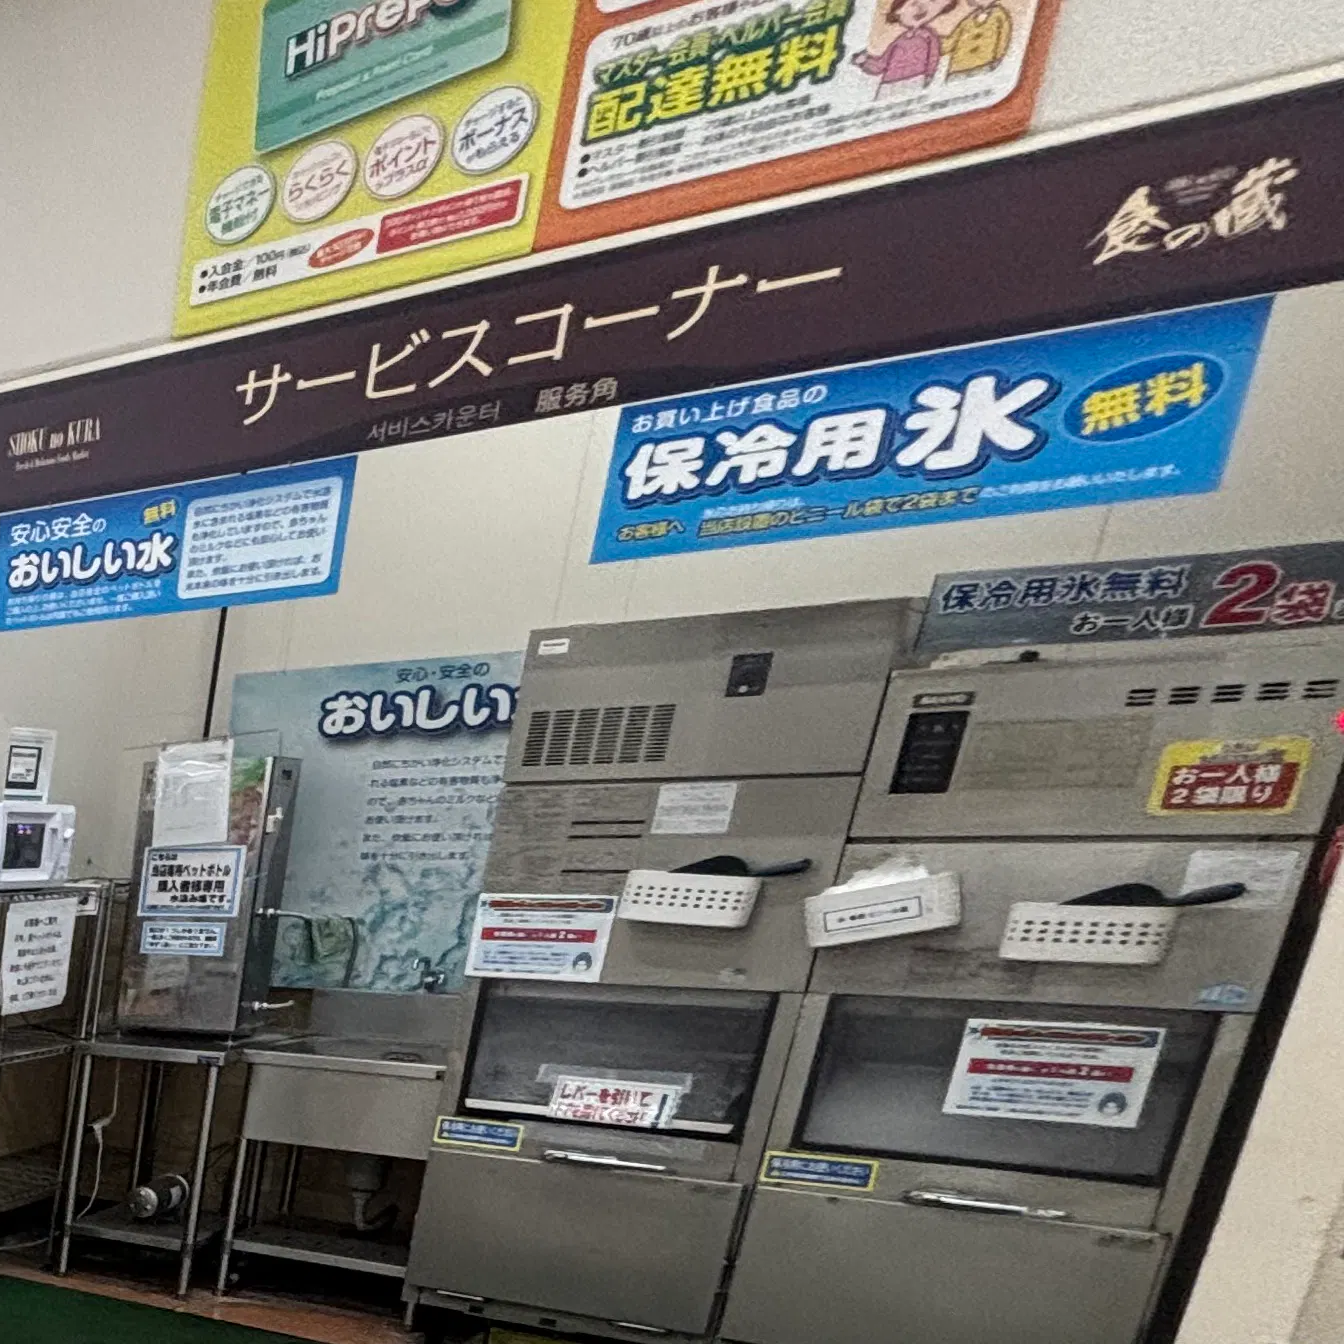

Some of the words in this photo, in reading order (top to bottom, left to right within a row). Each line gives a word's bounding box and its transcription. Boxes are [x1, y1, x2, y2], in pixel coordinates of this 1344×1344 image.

[285, 0, 462, 77] HiPreP
[585, 24, 841, 142] 配達無料
[459, 106, 528, 153] ボーナス
[287, 159, 352, 202] らくらく
[367, 134, 438, 178] ポイント
[235, 263, 844, 424] サービスコーナー
[534, 376, 619, 414] 服务角
[630, 382, 828, 434] お買い上げ食品の
[1078, 361, 1210, 438] 無料
[8, 428, 47, 458] SHOKU
[66, 416, 102, 446] KURA
[366, 400, 503, 444] 서비스카운터
[624, 374, 1052, 503] 保冷用氷
[9, 512, 108, 547] 安心安全の
[8, 530, 176, 590] おいしい水
[939, 564, 1193, 614] 保冷用氷無料
[1070, 603, 1193, 636] お一人様
[1200, 558, 1344, 629] 2袋
[395, 662, 491, 684] 安心・安全の
[321, 686, 520, 736] おいしい
[1171, 762, 1282, 787] お一人様
